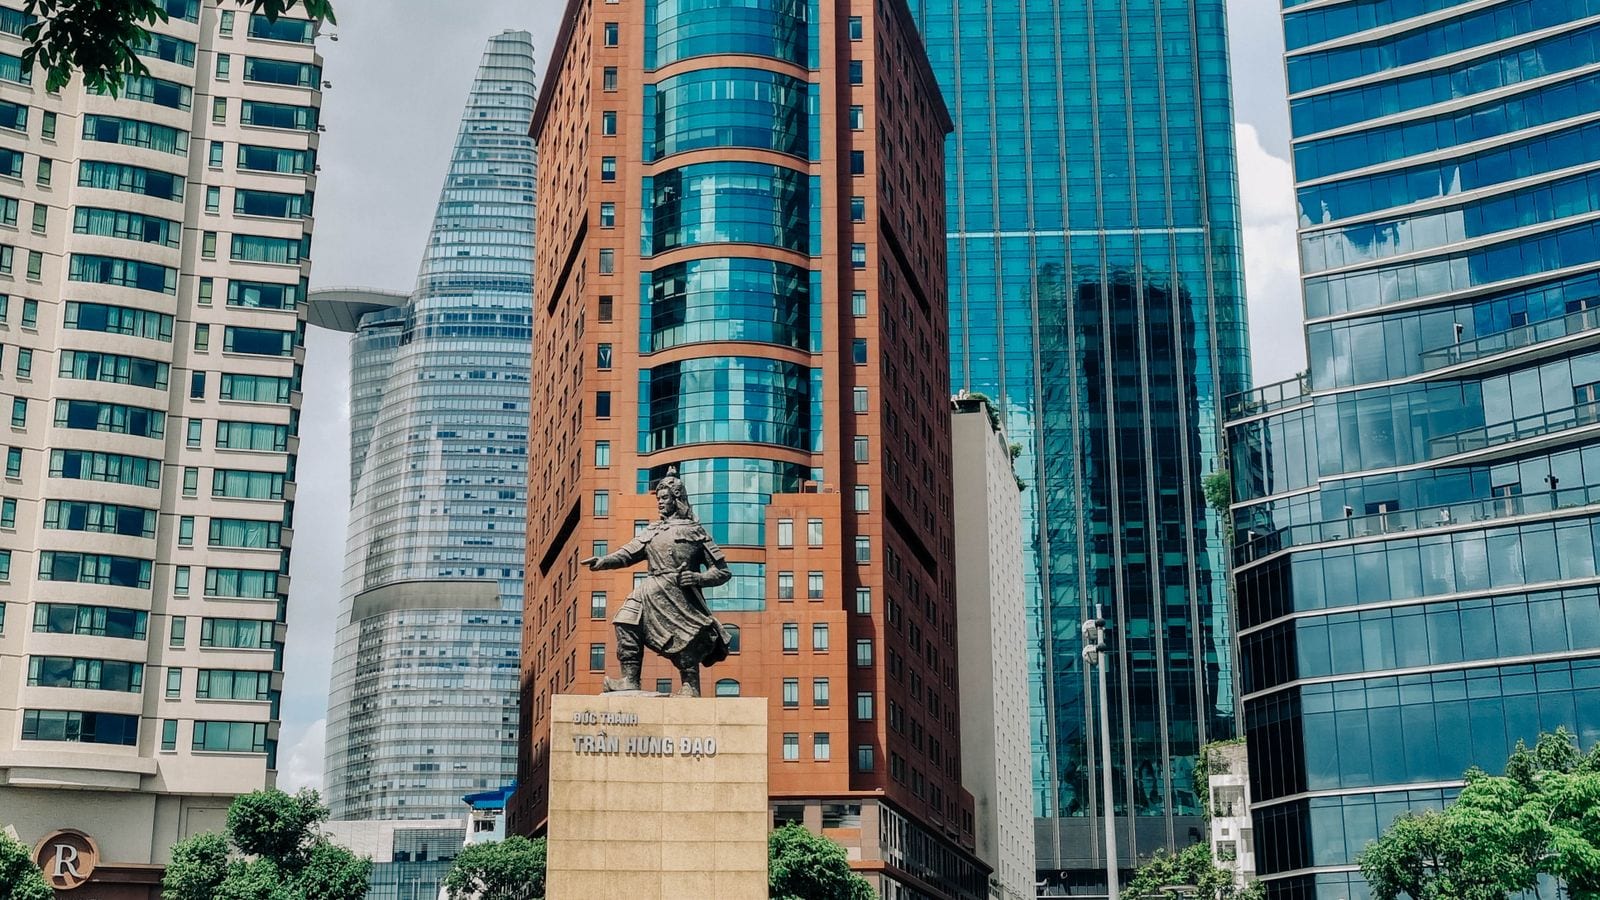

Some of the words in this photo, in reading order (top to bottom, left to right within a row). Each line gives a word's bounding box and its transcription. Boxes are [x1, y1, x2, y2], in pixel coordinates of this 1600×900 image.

[573, 731, 619, 754] TRẦN
[679, 737, 716, 761] ĐẠO
[52, 844, 88, 878] R
